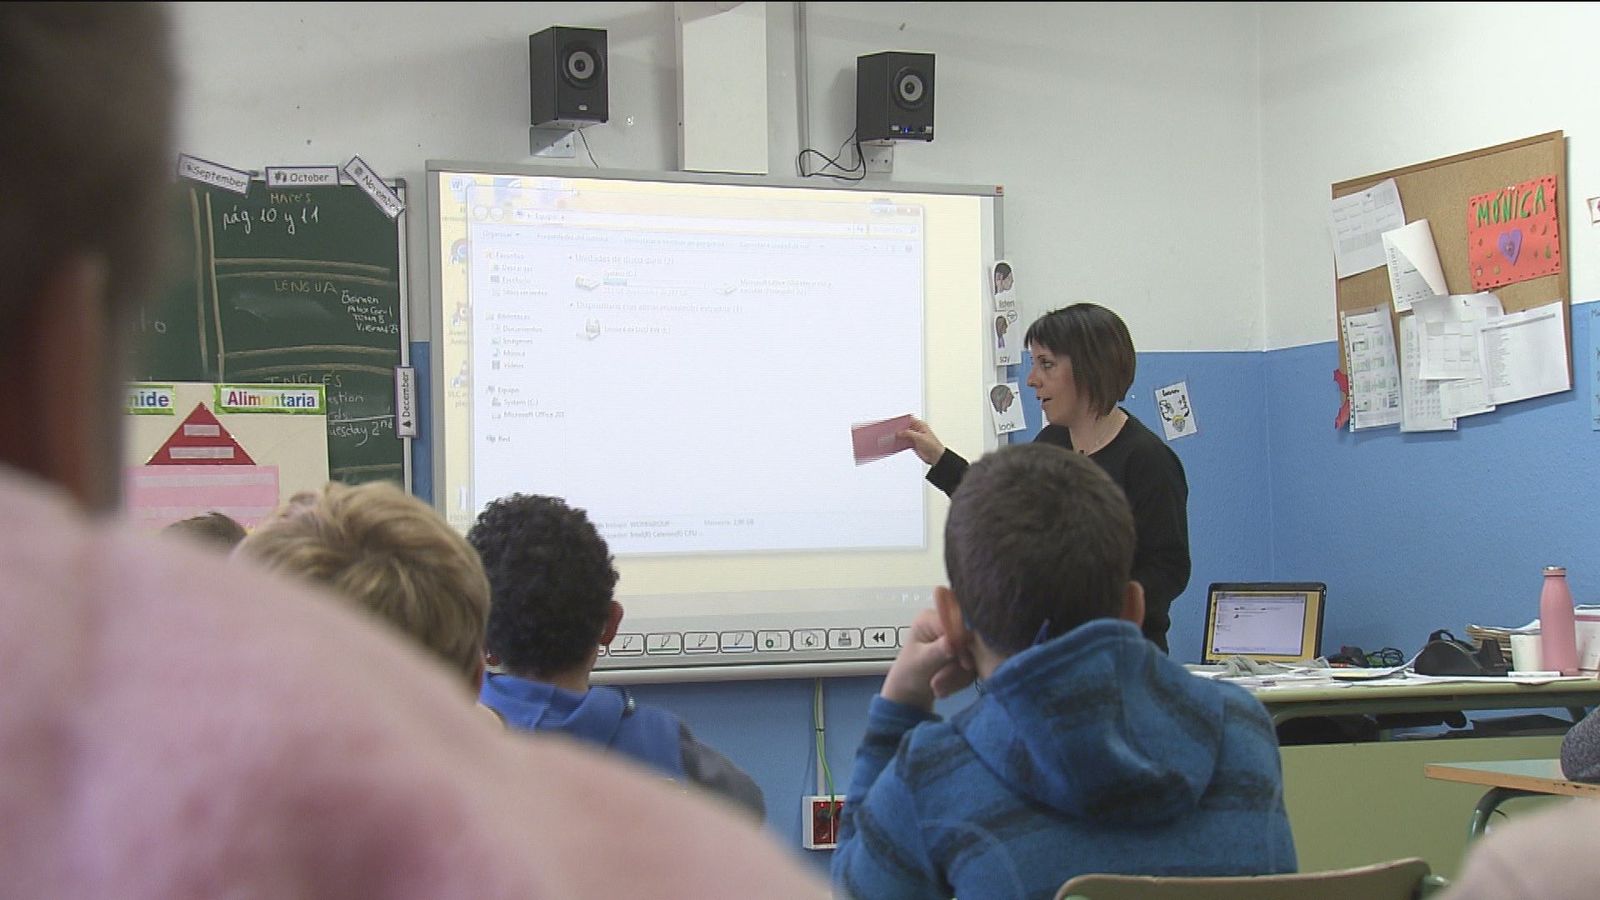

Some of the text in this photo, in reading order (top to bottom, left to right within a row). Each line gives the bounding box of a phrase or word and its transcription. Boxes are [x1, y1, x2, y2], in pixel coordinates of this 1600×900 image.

[289, 171, 330, 183] October
[363, 174, 399, 212] November
[1475, 184, 1547, 228] MÓNICA
[260, 207, 278, 223] 10
[284, 211, 296, 235] y
[301, 205, 319, 224] 11
[273, 280, 338, 296] LENGUA
[227, 391, 315, 408] Alimentaria
[401, 371, 411, 418] December
[329, 423, 368, 448] uesday
